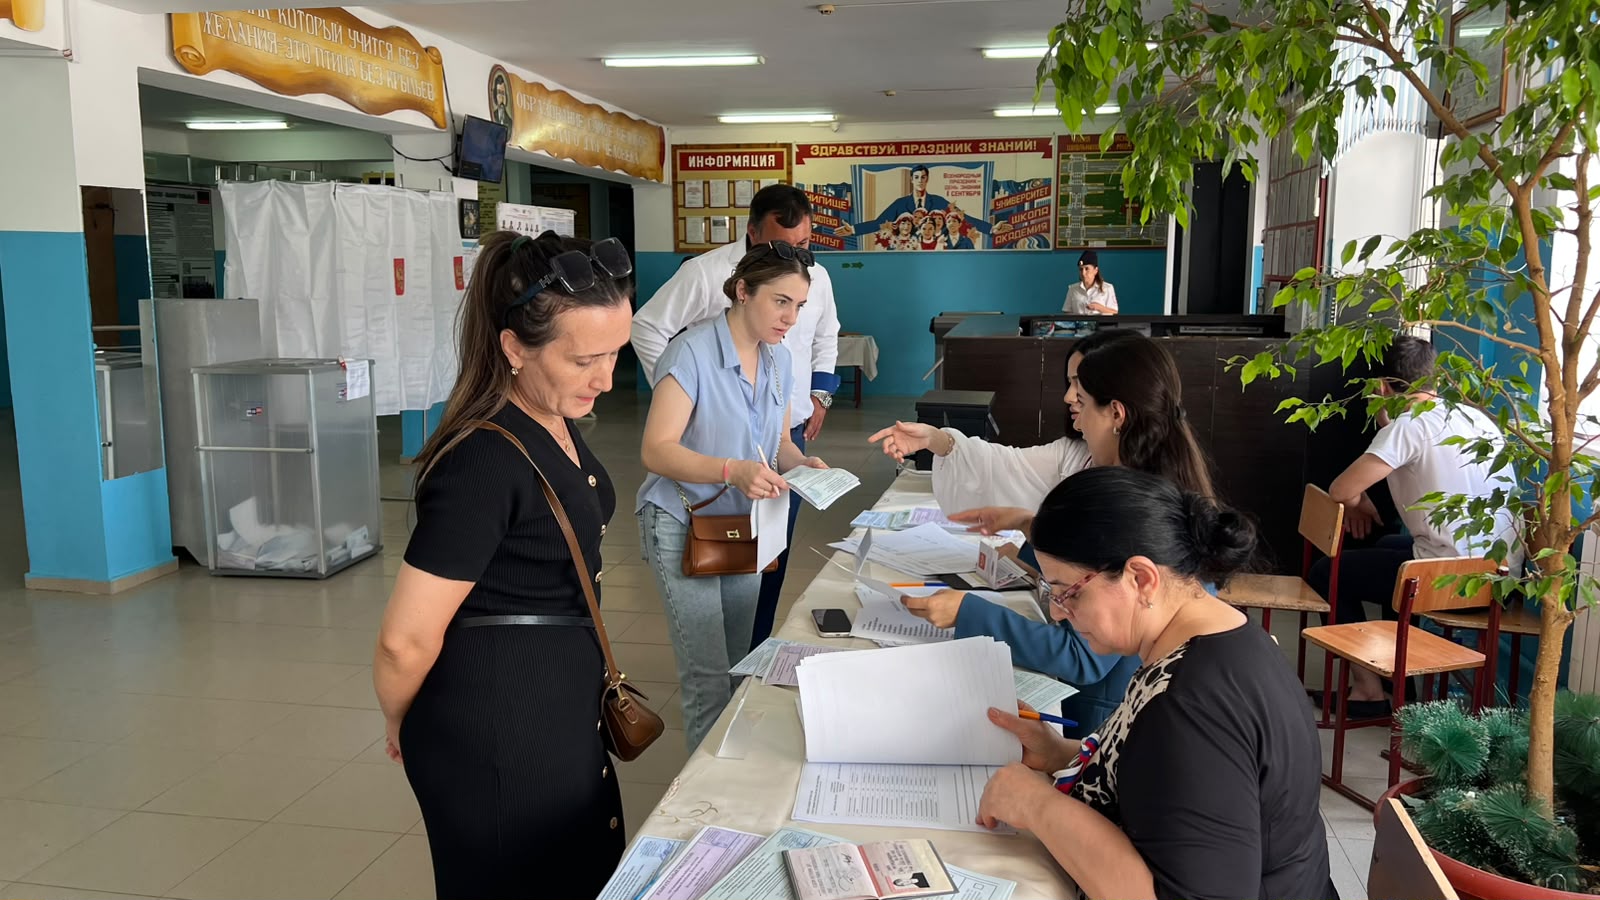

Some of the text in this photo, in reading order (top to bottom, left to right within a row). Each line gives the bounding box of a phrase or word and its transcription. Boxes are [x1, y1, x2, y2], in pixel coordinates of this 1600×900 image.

[278, 9, 343, 45] КОТОРЫЙ
[348, 28, 394, 61] УЧИТСЯ
[398, 46, 420, 70] БЕЗ
[315, 47, 356, 78] ПТИЦА
[360, 60, 384, 86] БЕЗ
[386, 72, 435, 101] КРЫЛЬЕВ
[901, 142, 972, 155] ПРАЗДНИК
[979, 140, 1037, 153] ЗНАНИЙ!
[688, 154, 776, 168] ИНФОРМАЦИЯ
[995, 186, 1049, 209] УНИВЕРСИТЕТ
[1011, 206, 1049, 224] ШКОЛА
[994, 222, 1048, 244] АКАДЕМИЯ
